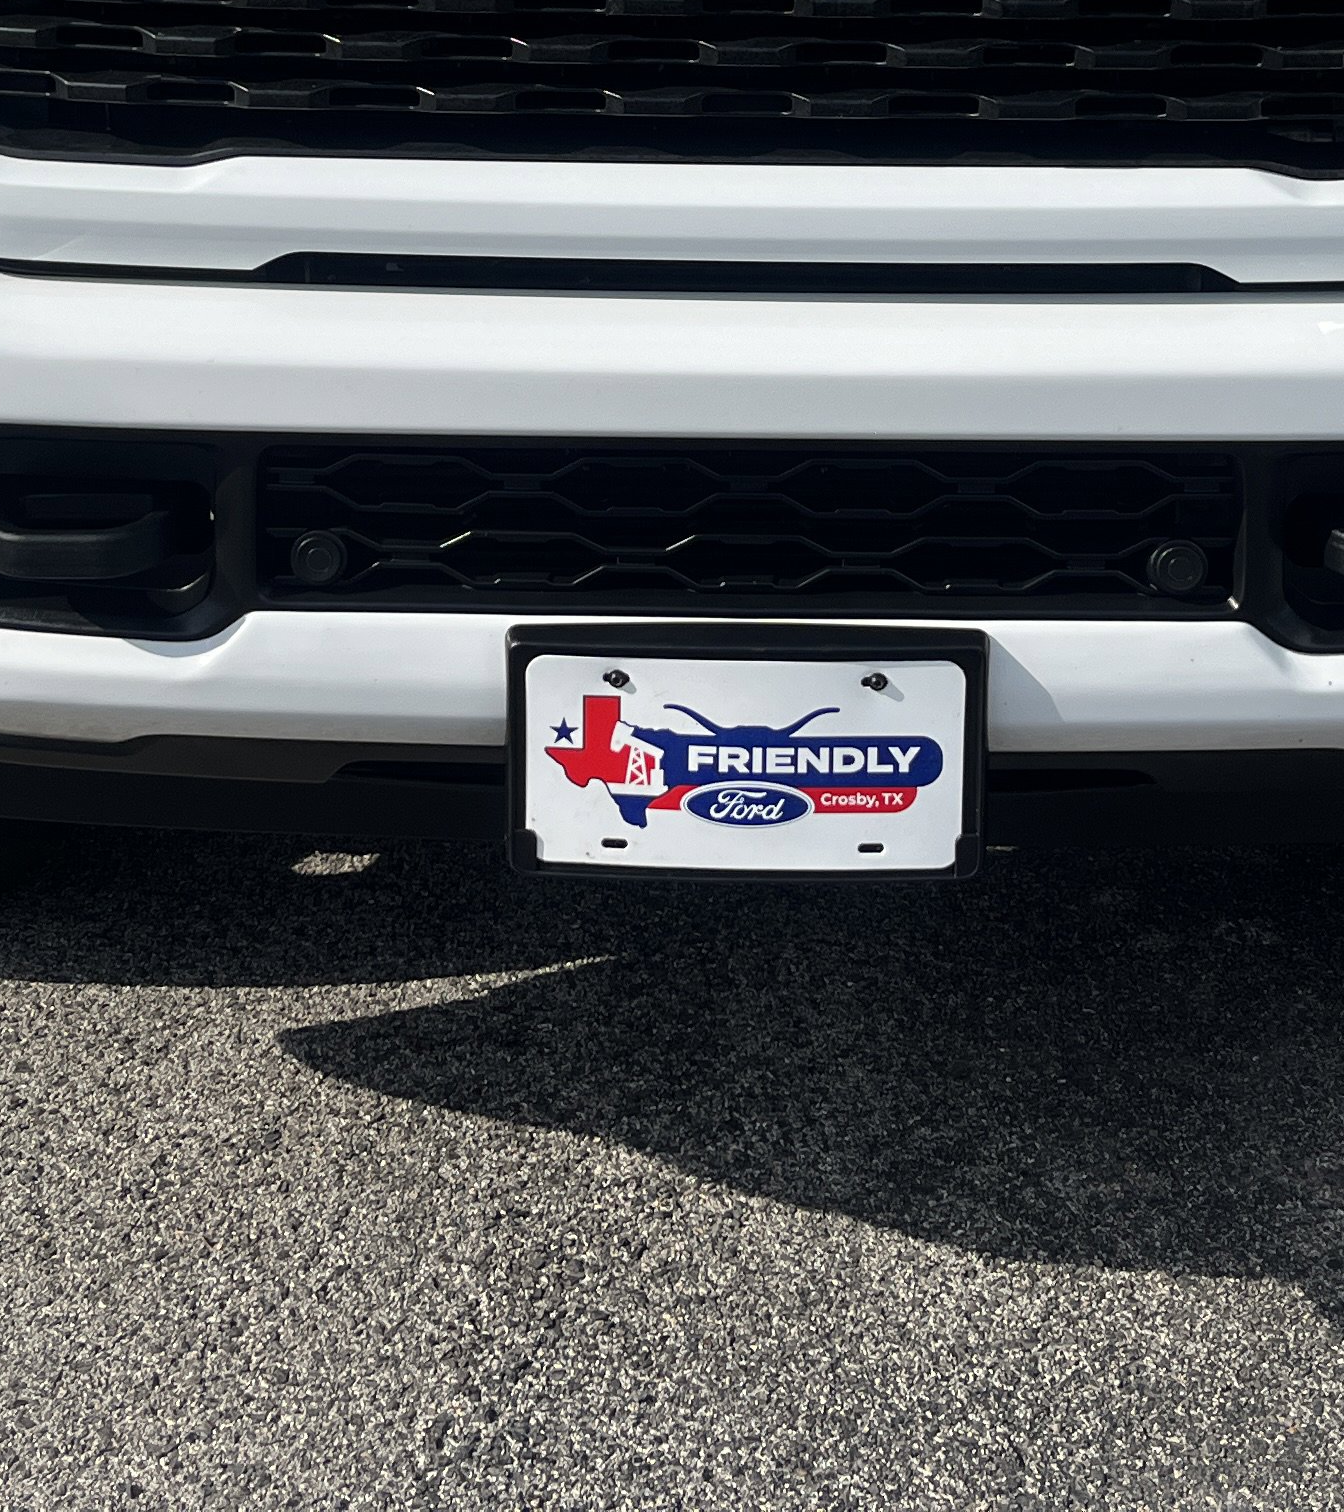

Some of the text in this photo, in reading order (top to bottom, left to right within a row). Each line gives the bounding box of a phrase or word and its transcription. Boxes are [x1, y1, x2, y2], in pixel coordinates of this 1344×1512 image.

[687, 744, 921, 774] FRIENDLY
[709, 789, 786, 821] Ford
[820, 792, 904, 808] Crosby, TX
